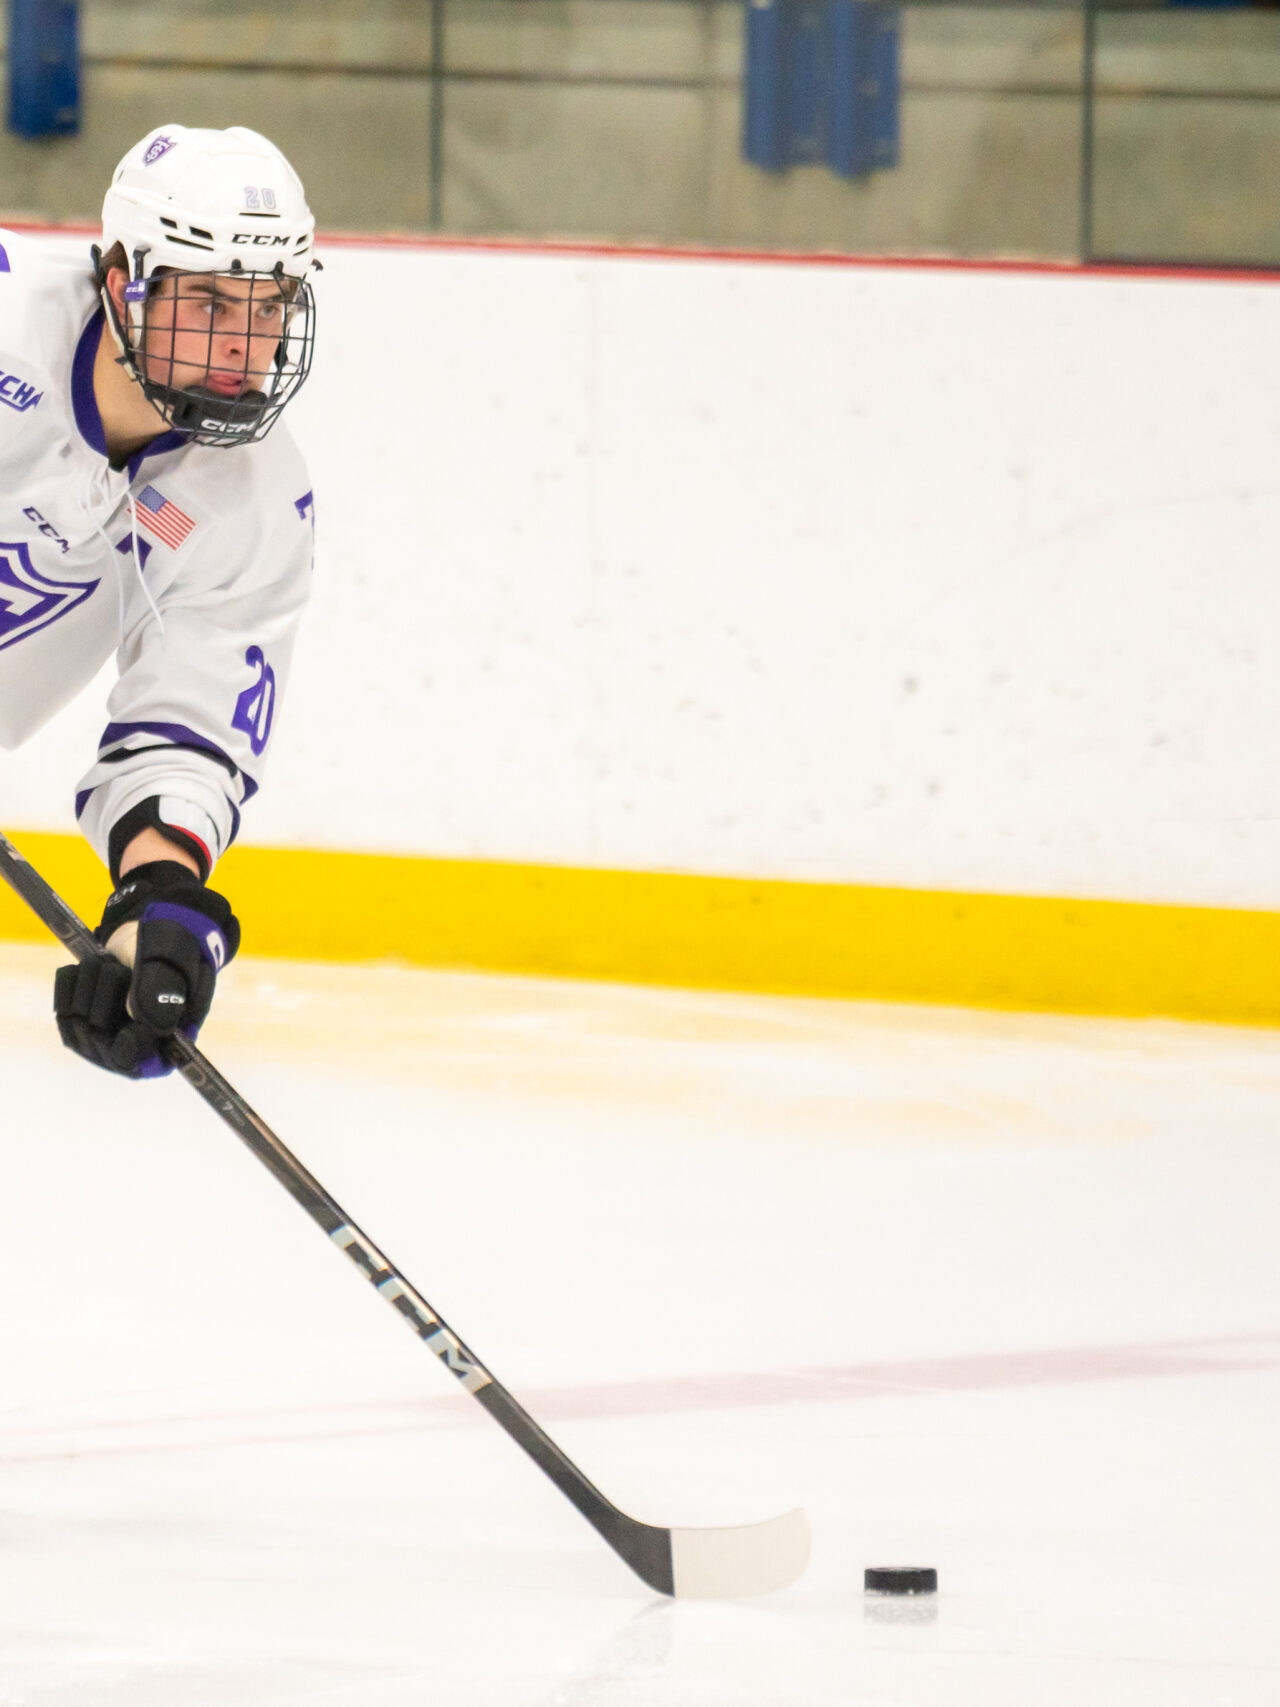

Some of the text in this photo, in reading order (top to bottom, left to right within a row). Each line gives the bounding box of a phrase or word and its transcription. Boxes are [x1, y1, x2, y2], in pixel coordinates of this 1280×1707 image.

[244, 186, 277, 209] 20
[231, 233, 291, 247] CCM
[201, 418, 257, 433] CCM
[231, 644, 276, 757] 20
[327, 1223, 494, 1394] CCM
